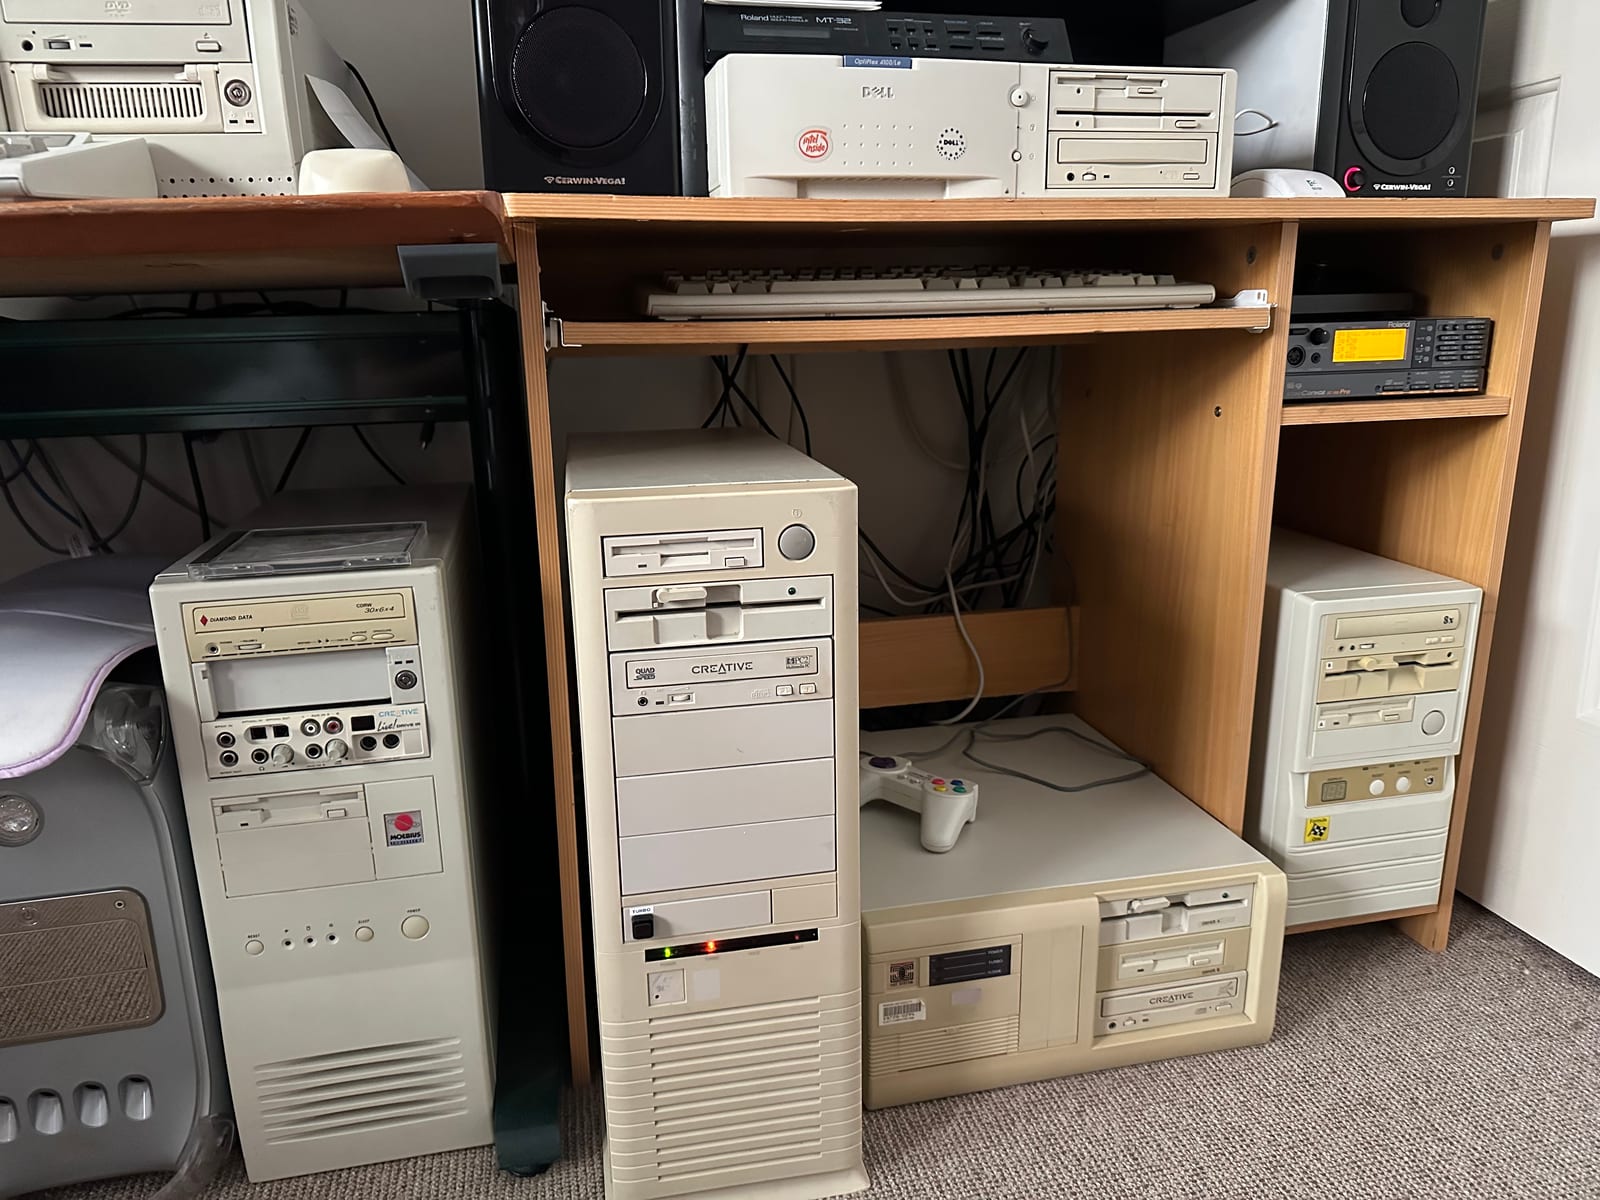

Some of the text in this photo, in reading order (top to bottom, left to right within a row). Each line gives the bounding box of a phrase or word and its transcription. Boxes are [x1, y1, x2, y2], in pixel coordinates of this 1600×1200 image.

[816, 16, 852, 24] MT-32
[862, 86, 894, 99] DELL
[805, 142, 826, 153] inside
[554, 176, 626, 185] CERWIN-VEGA!
[1380, 183, 1431, 191] CERWIN-VEGA!
[210, 615, 236, 623] DIAMOND
[635, 667, 655, 675] QUAD
[691, 661, 753, 675] CREATIVE
[1149, 992, 1194, 1004] CREATIVE
